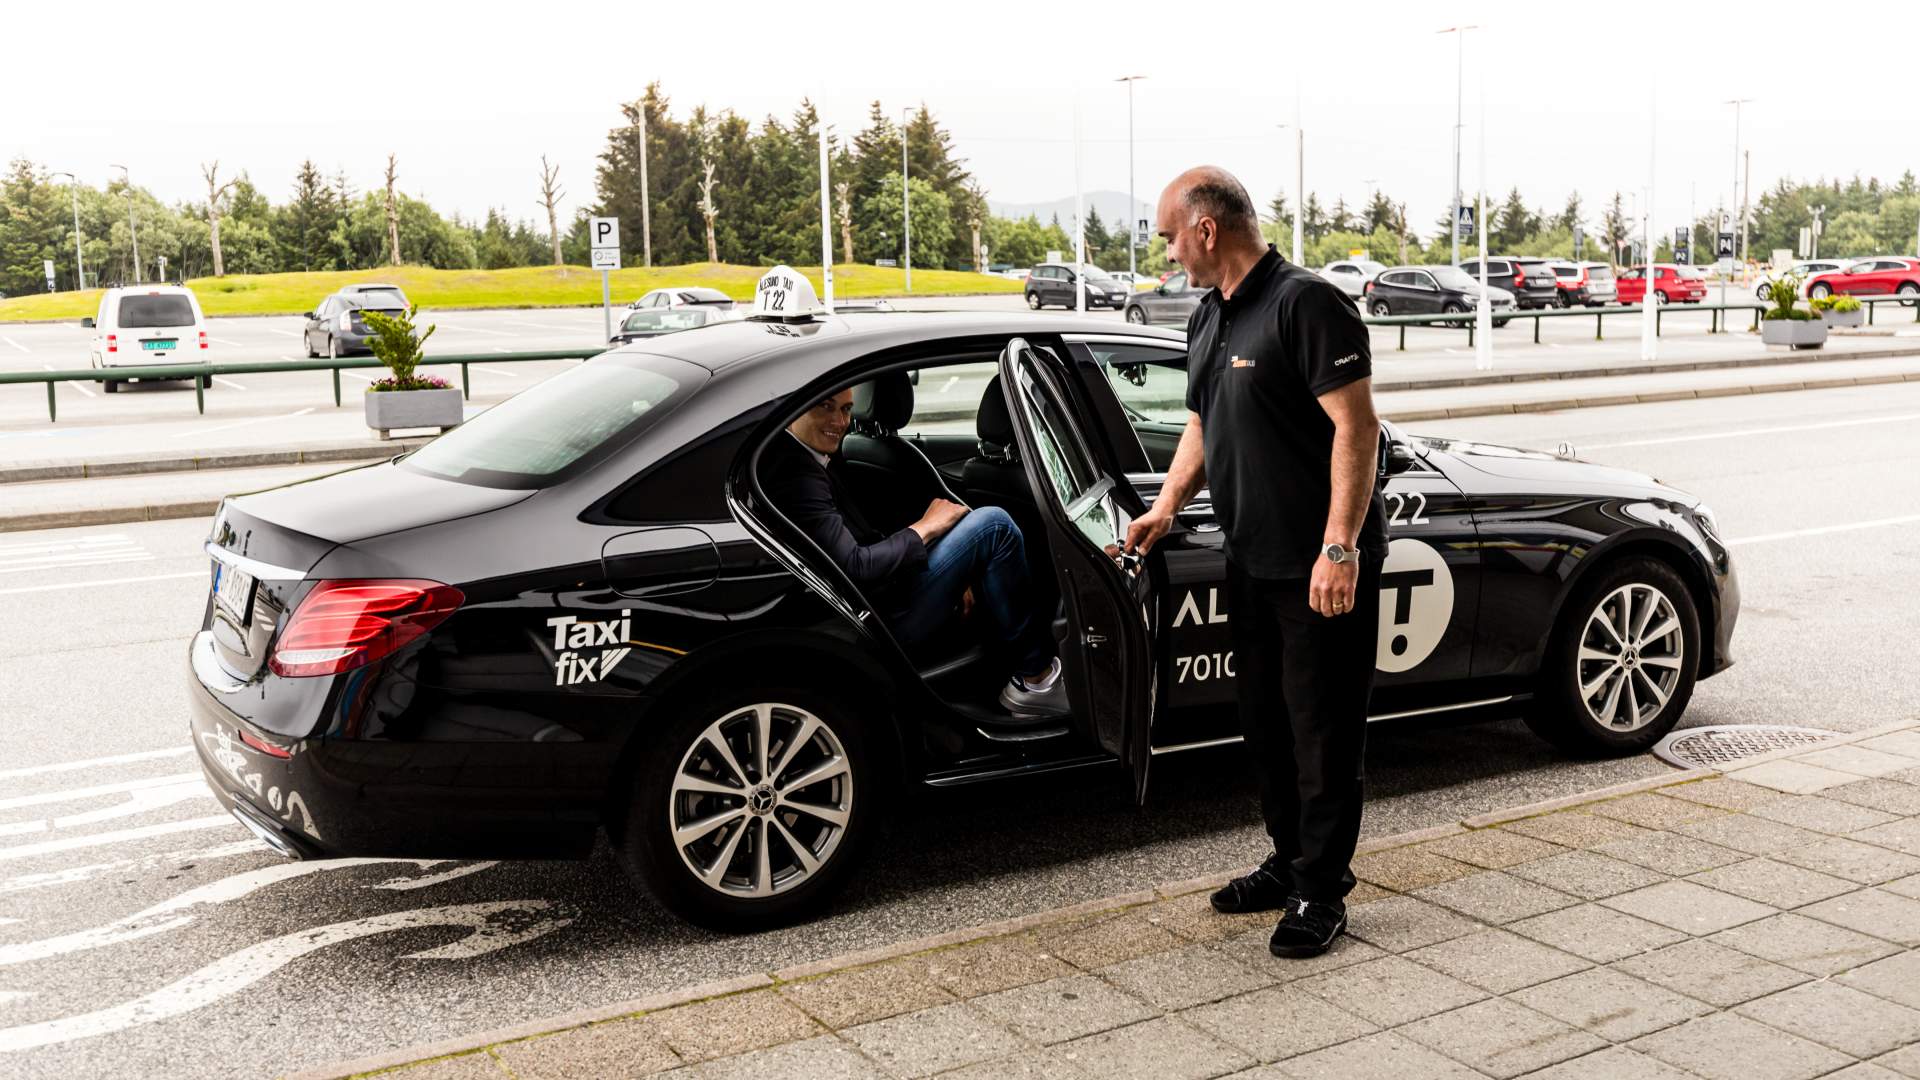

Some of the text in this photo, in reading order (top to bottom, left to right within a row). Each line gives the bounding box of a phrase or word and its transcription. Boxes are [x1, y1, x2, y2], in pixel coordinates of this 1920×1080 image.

[597, 222, 612, 244] P
[1720, 238, 1732, 252] P4
[783, 276, 794, 292] TAXI
[763, 289, 786, 311] T 22
[1385, 491, 1430, 527] 22
[547, 608, 632, 650] Taxi
[554, 651, 599, 686] fix
